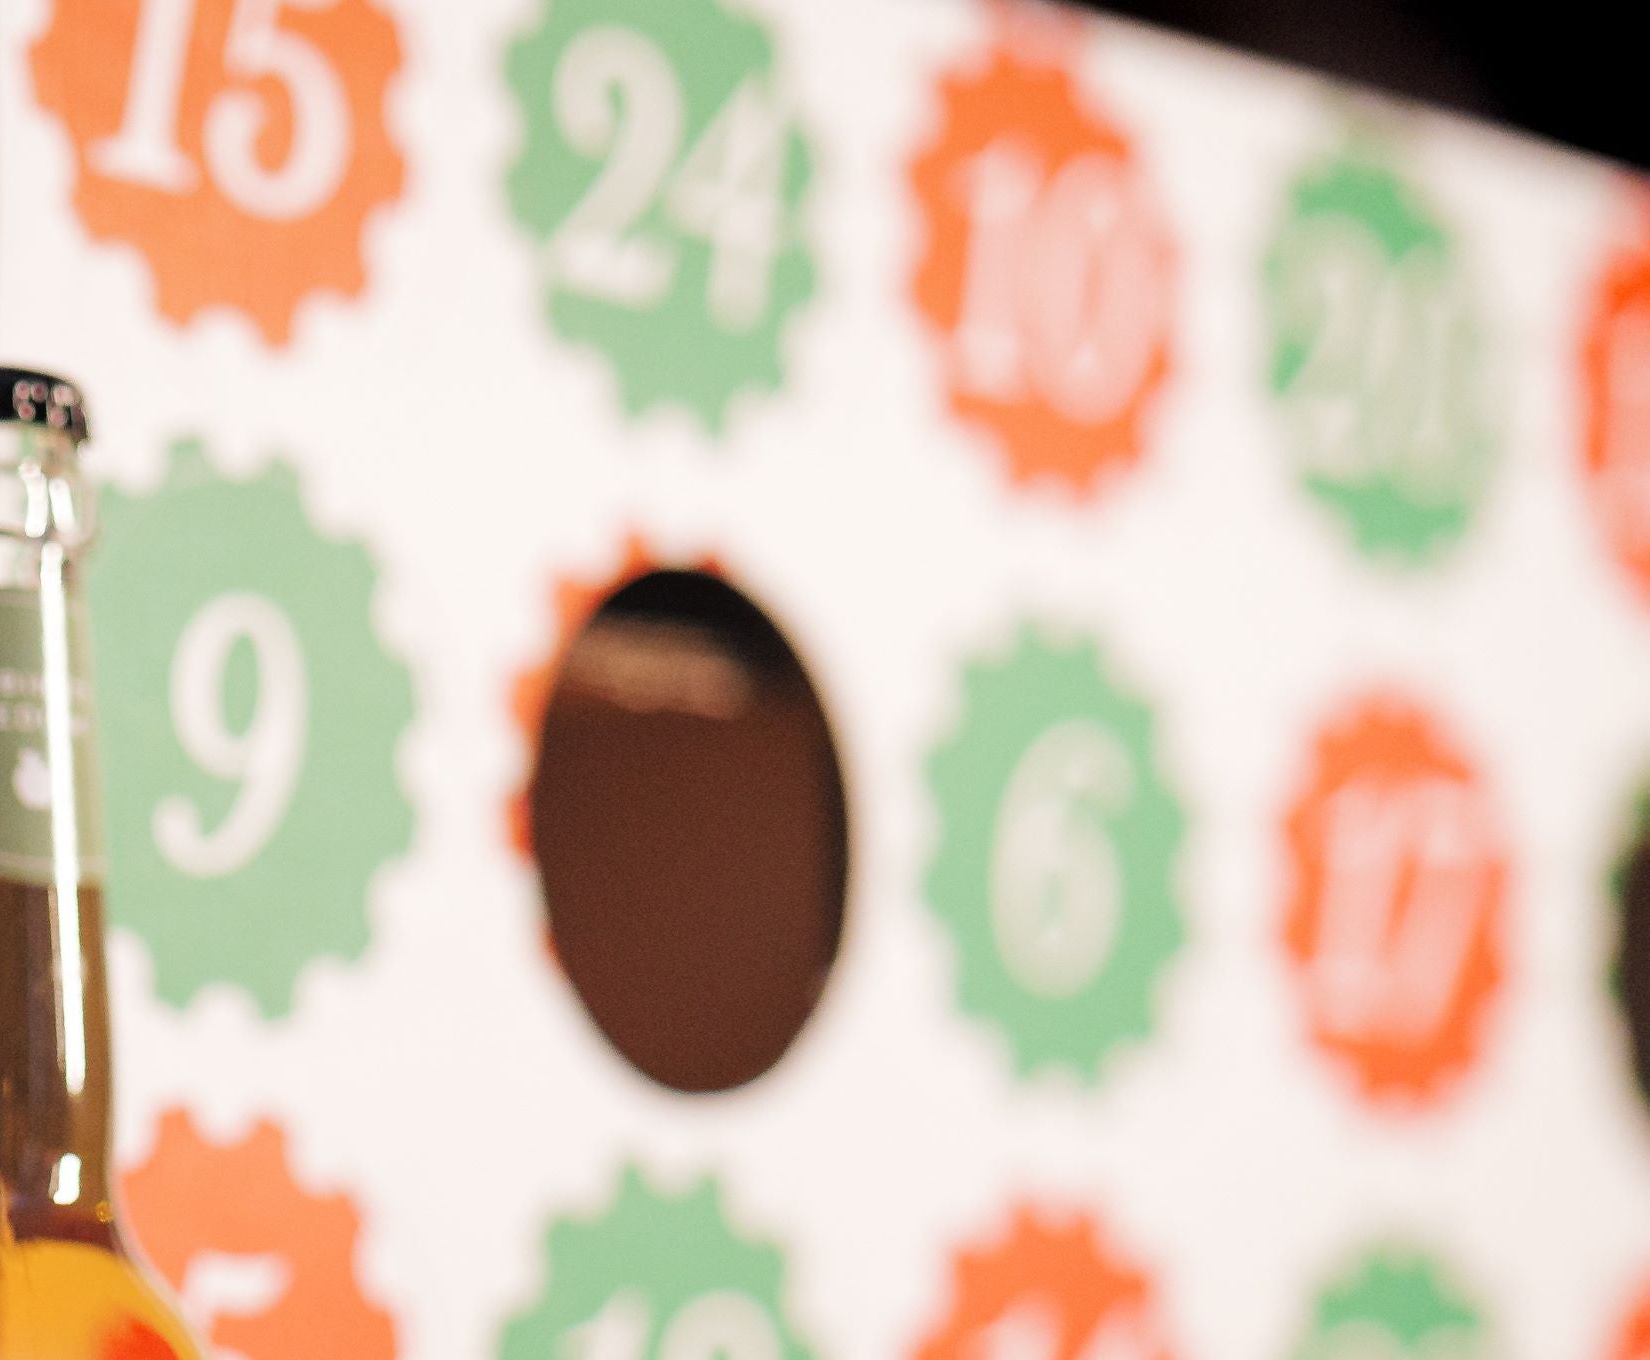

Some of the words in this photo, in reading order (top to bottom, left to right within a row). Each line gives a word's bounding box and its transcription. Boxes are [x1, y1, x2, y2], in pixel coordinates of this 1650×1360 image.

[85, 0, 352, 222] 15
[548, 26, 792, 334] 24
[153, 590, 308, 878] 9
[987, 717, 1140, 1000] 6
